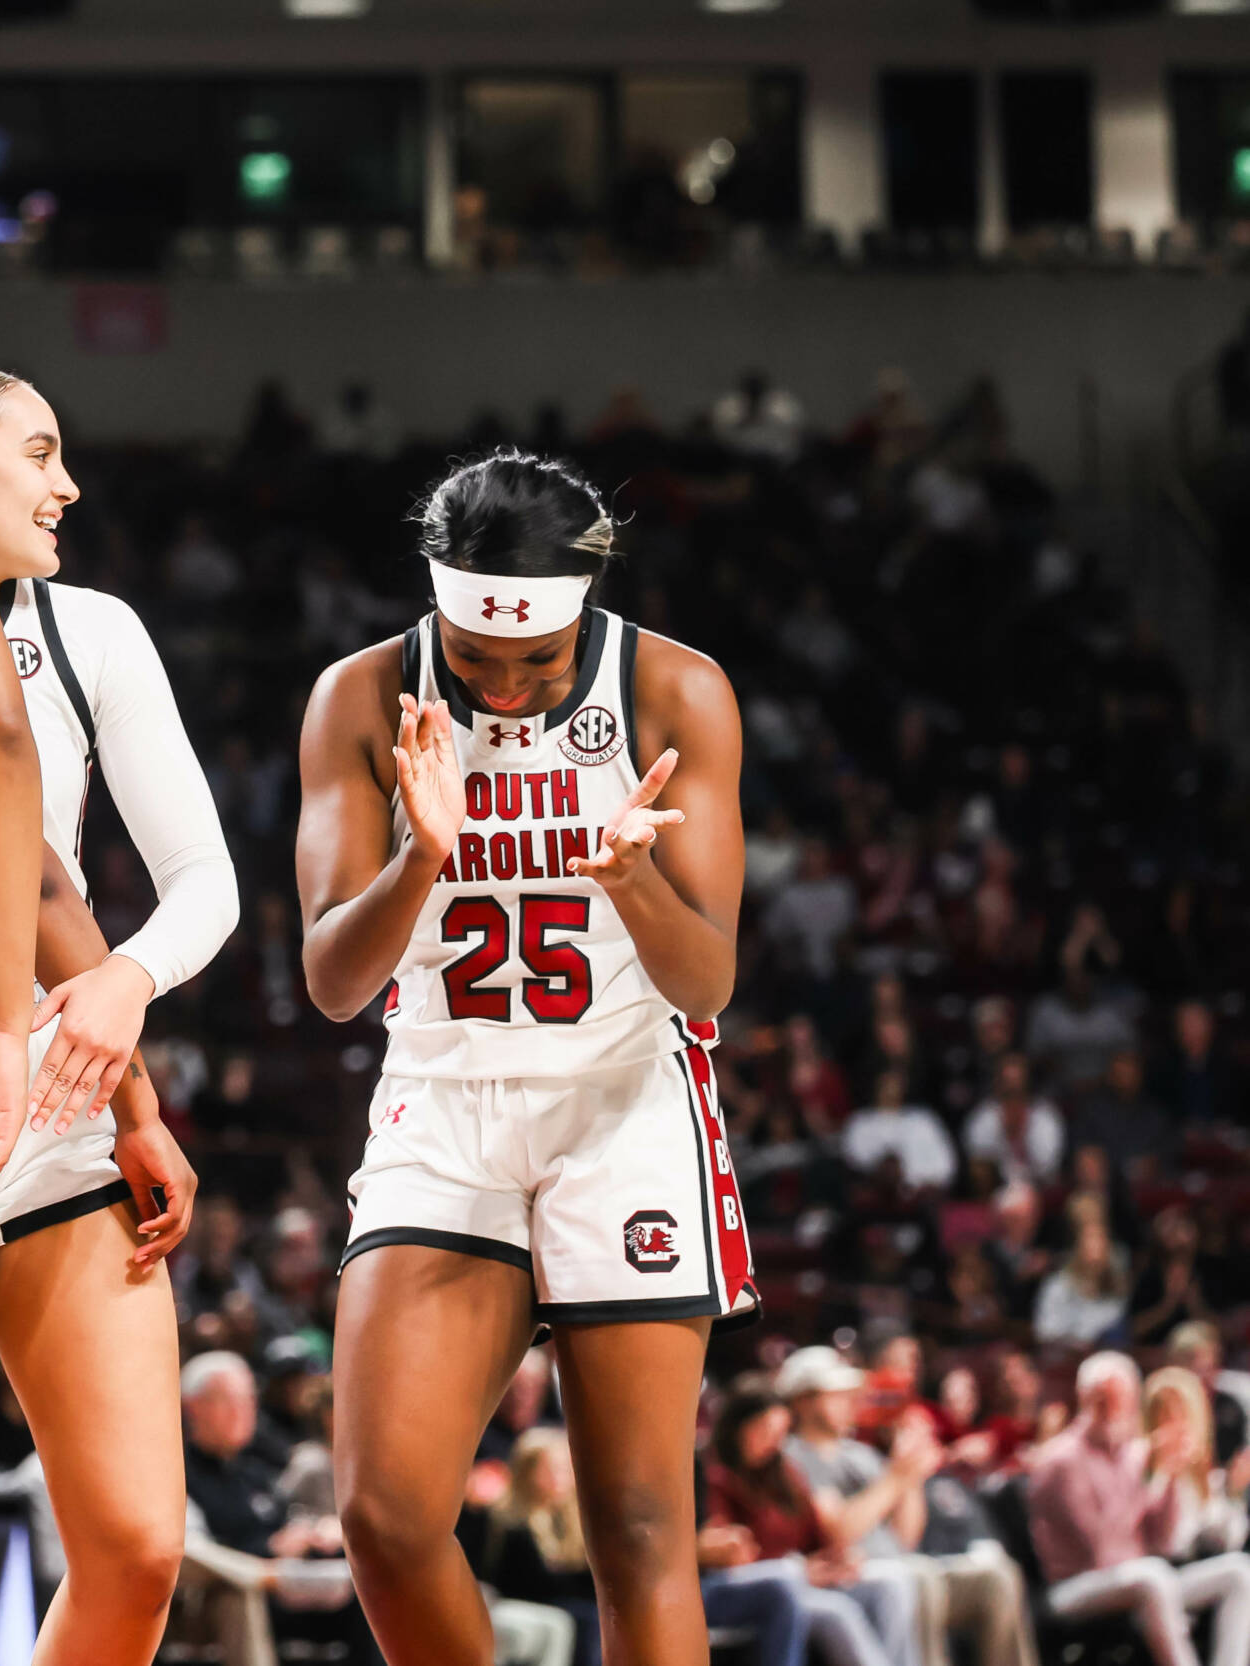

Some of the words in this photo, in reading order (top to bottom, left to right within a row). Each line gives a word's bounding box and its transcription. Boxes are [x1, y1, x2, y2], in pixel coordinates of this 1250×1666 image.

[7, 640, 40, 677] EC
[572, 708, 614, 750] SEC
[565, 745, 618, 764] GRADUATE
[464, 768, 581, 821] OUTH
[441, 893, 593, 1024] 25
